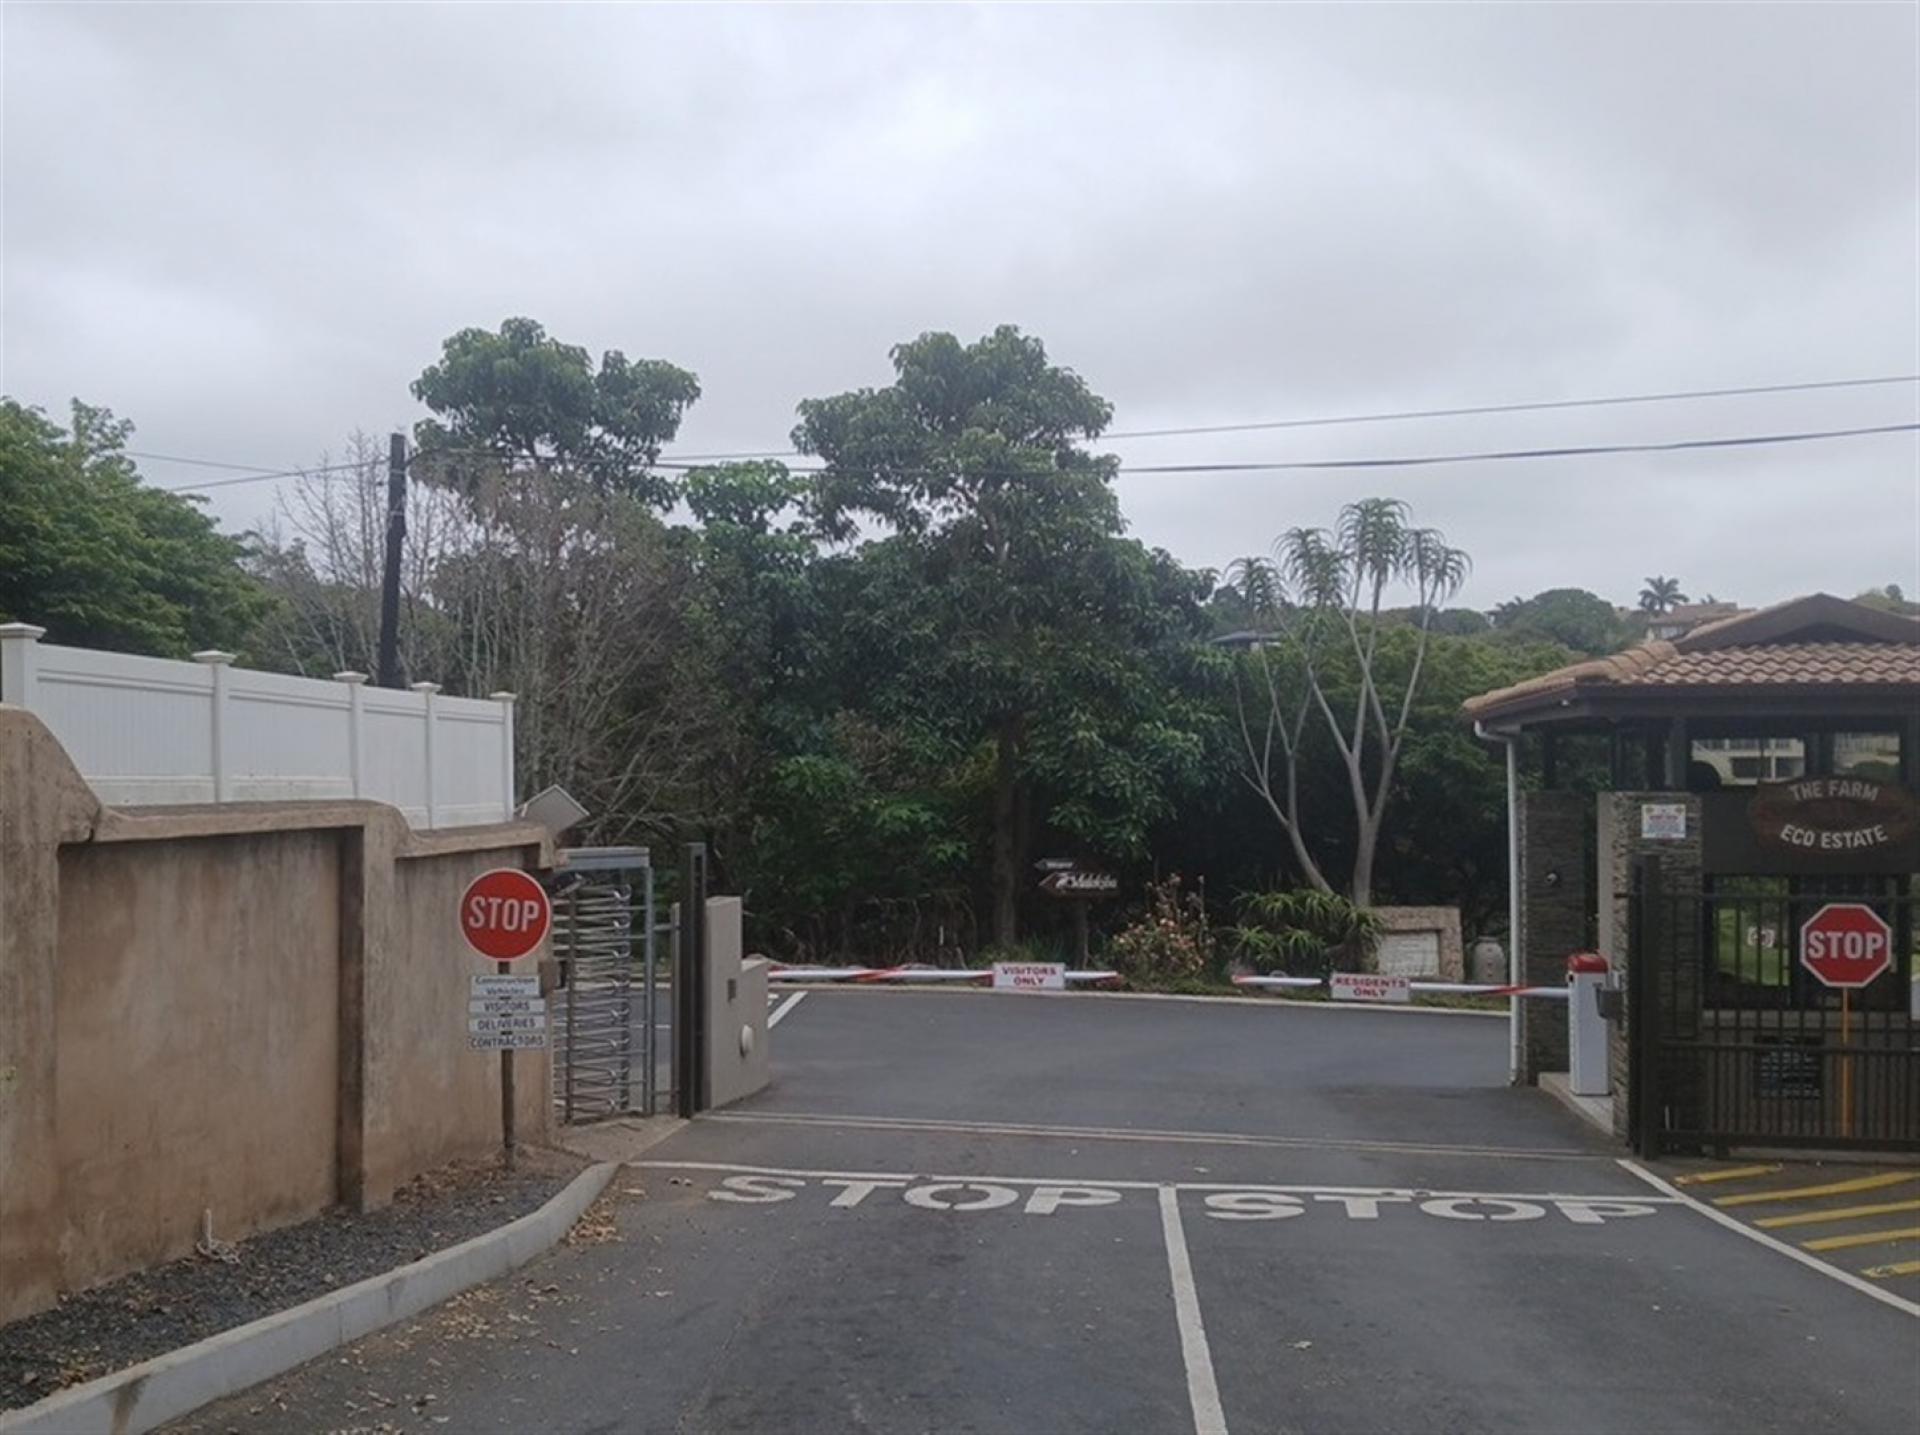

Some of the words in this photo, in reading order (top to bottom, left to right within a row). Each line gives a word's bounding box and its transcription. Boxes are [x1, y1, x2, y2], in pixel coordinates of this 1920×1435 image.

[1788, 780, 1823, 801] THE
[1828, 780, 1880, 801] FARM
[1780, 824, 1815, 846] ECO
[1821, 824, 1888, 849] ESTATE
[469, 895, 540, 932] STOP
[1807, 930, 1885, 959] STOP
[1002, 966, 1057, 975] VISITORS
[1014, 976, 1044, 986] ONLY
[1336, 977, 1407, 988] RESIDENTS
[1353, 987, 1387, 996] ONLY
[484, 1000, 530, 1012] VISITORS
[477, 1017, 536, 1031] DELIVERIES
[471, 1034, 544, 1048] CONTRACTORS
[707, 1175, 1122, 1214] STOP
[1204, 1182, 1657, 1224] STOP
